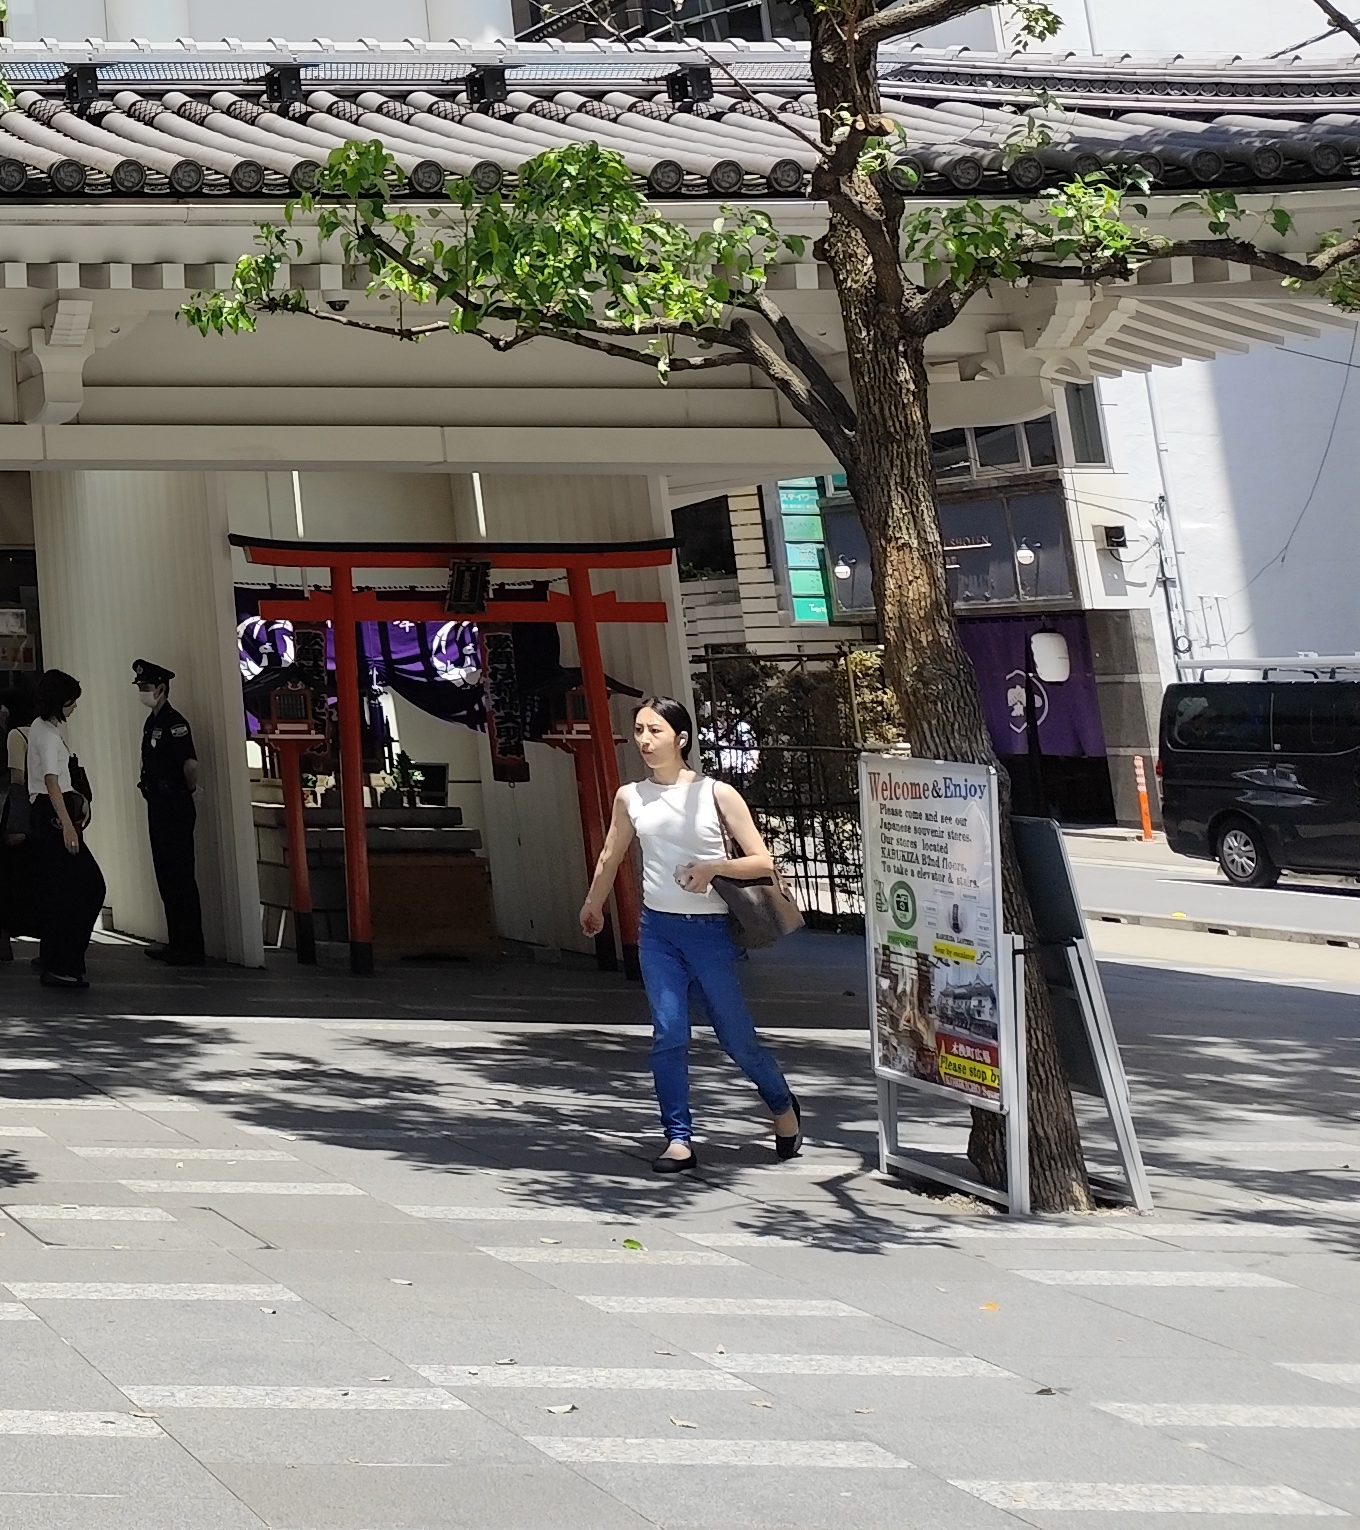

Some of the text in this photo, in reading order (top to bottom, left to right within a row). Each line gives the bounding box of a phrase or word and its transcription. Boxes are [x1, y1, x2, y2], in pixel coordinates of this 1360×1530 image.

[879, 803, 968, 827] Please come and see our
[879, 818, 972, 843] Japanese souvenir stores.
[880, 832, 949, 855] Our stores located
[880, 846, 920, 865] KABUKIZA
[922, 853, 940, 869] B2nd
[881, 861, 892, 874] To
[893, 864, 909, 877] take
[917, 867, 946, 884] elevator
[940, 1054, 967, 1075] Please
[969, 1065, 988, 1082] stop
